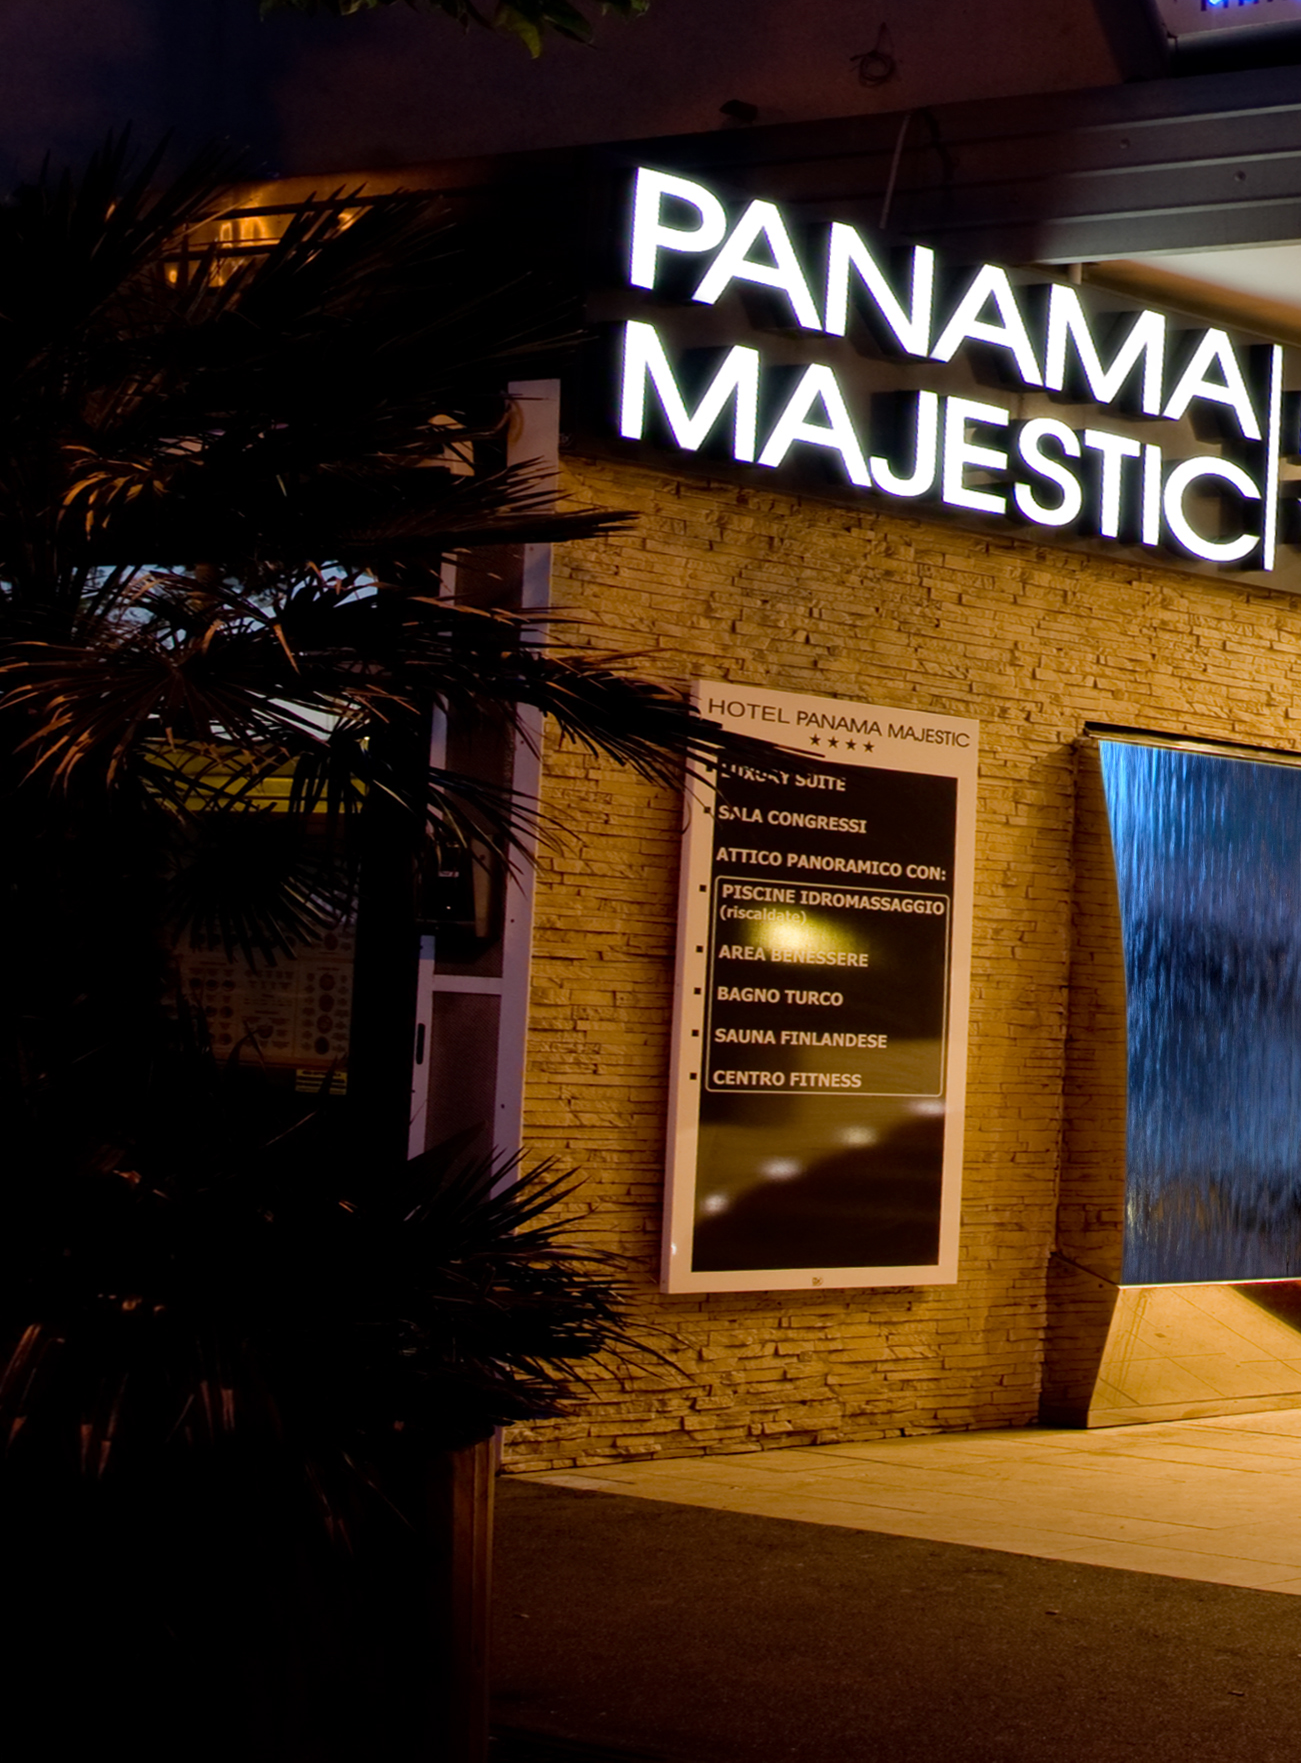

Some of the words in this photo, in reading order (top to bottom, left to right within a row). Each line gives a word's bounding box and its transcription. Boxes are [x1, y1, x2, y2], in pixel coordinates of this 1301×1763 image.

[628, 165, 1263, 442] PANAMA
[618, 318, 1262, 566] MAJESTIC
[707, 697, 791, 724] HOTEL
[796, 710, 882, 737] PANAMA
[887, 723, 971, 748] MAJESTIC
[795, 773, 847, 792] SUITE
[718, 804, 764, 823] SALA
[767, 810, 868, 834] CONGRESSI
[715, 846, 783, 868] ATTICO
[786, 852, 903, 879] PANORAMICO
[905, 863, 947, 882] CON:
[721, 883, 796, 905] PISCINE
[799, 891, 945, 916] IDROMASSAGGIO
[719, 904, 808, 925] (riscaldate)
[718, 944, 767, 963] AREA
[770, 947, 870, 968] BENESSERE
[716, 986, 781, 1004] BAGNO
[784, 988, 844, 1007] TURCO
[713, 1028, 776, 1046] SAUNA
[780, 1030, 888, 1049] FINLANDESE
[712, 1069, 786, 1087] CENTRO
[789, 1071, 862, 1089] FITNESS
